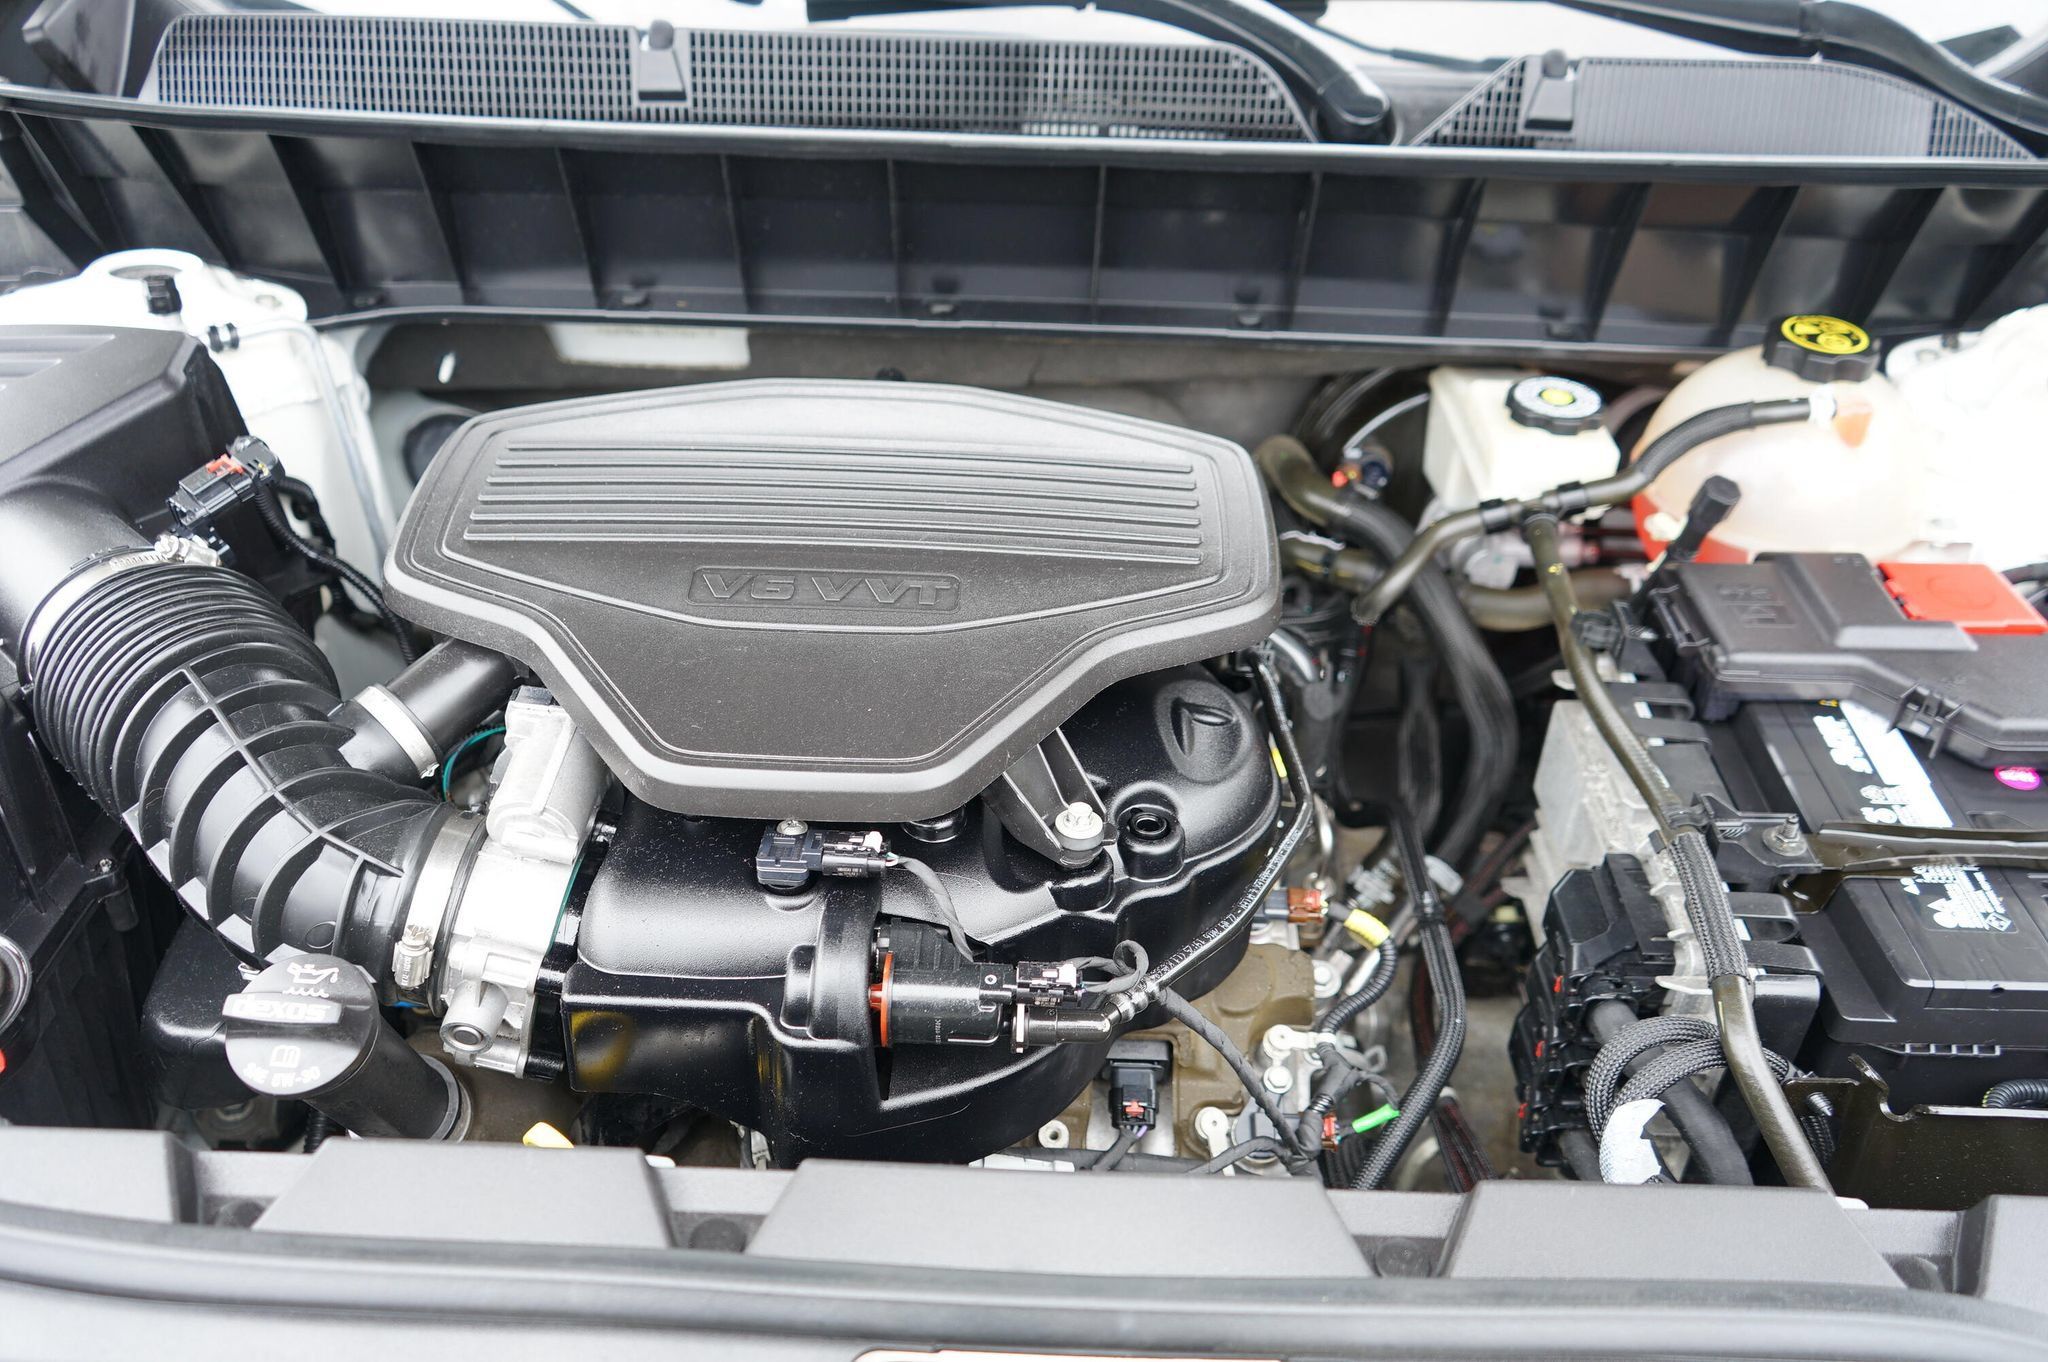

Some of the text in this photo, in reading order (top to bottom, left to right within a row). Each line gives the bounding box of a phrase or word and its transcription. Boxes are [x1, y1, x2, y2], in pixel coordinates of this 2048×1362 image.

[702, 572, 952, 606] V6 VVT
[231, 994, 331, 1022] dexos
